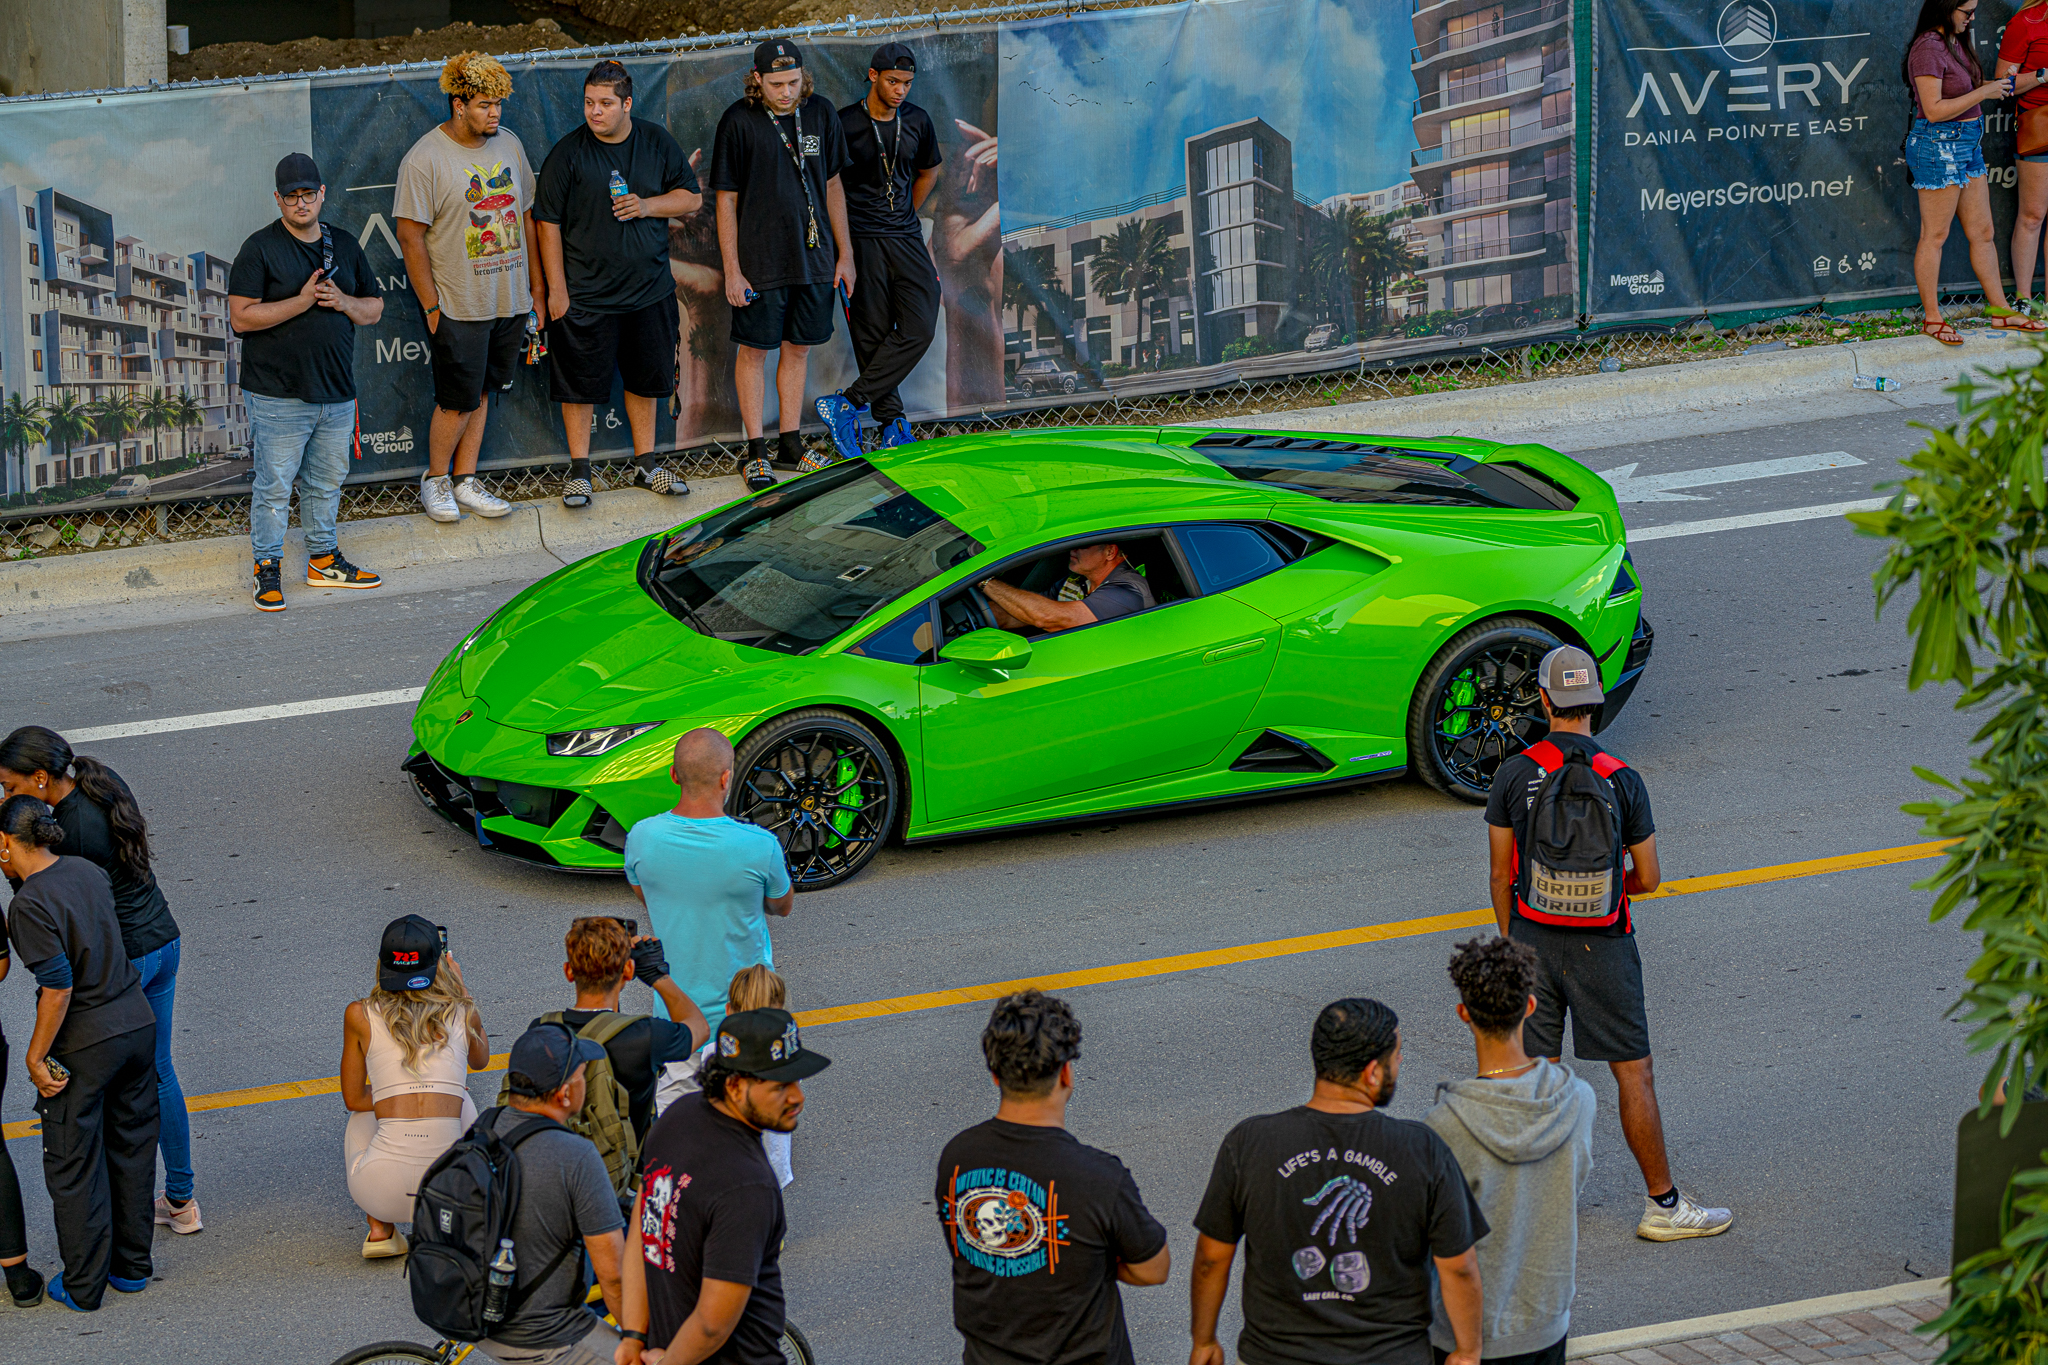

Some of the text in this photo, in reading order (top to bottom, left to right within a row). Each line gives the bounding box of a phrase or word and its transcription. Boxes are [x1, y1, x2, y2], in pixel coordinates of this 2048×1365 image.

[1625, 57, 1869, 118] AVERY
[1624, 116, 1869, 146] DANIA POINTE EAST
[1640, 175, 1854, 215] MeyersGroup.net
[1610, 273, 1649, 287] Meyers
[1629, 283, 1665, 295] Group
[373, 440, 414, 454] Group
[1536, 876, 1604, 897] BRIDE
[1535, 892, 1602, 913] BRIDE
[994, 1167, 1007, 1187] IS
[1278, 1147, 1398, 1186] LIFE'S A GAMBLE
[995, 1256, 1006, 1277] IS
[1005, 1247, 1048, 1278] POSSIBLE
[1302, 1292, 1321, 1301] LAST
[1321, 1291, 1340, 1300] CALL
